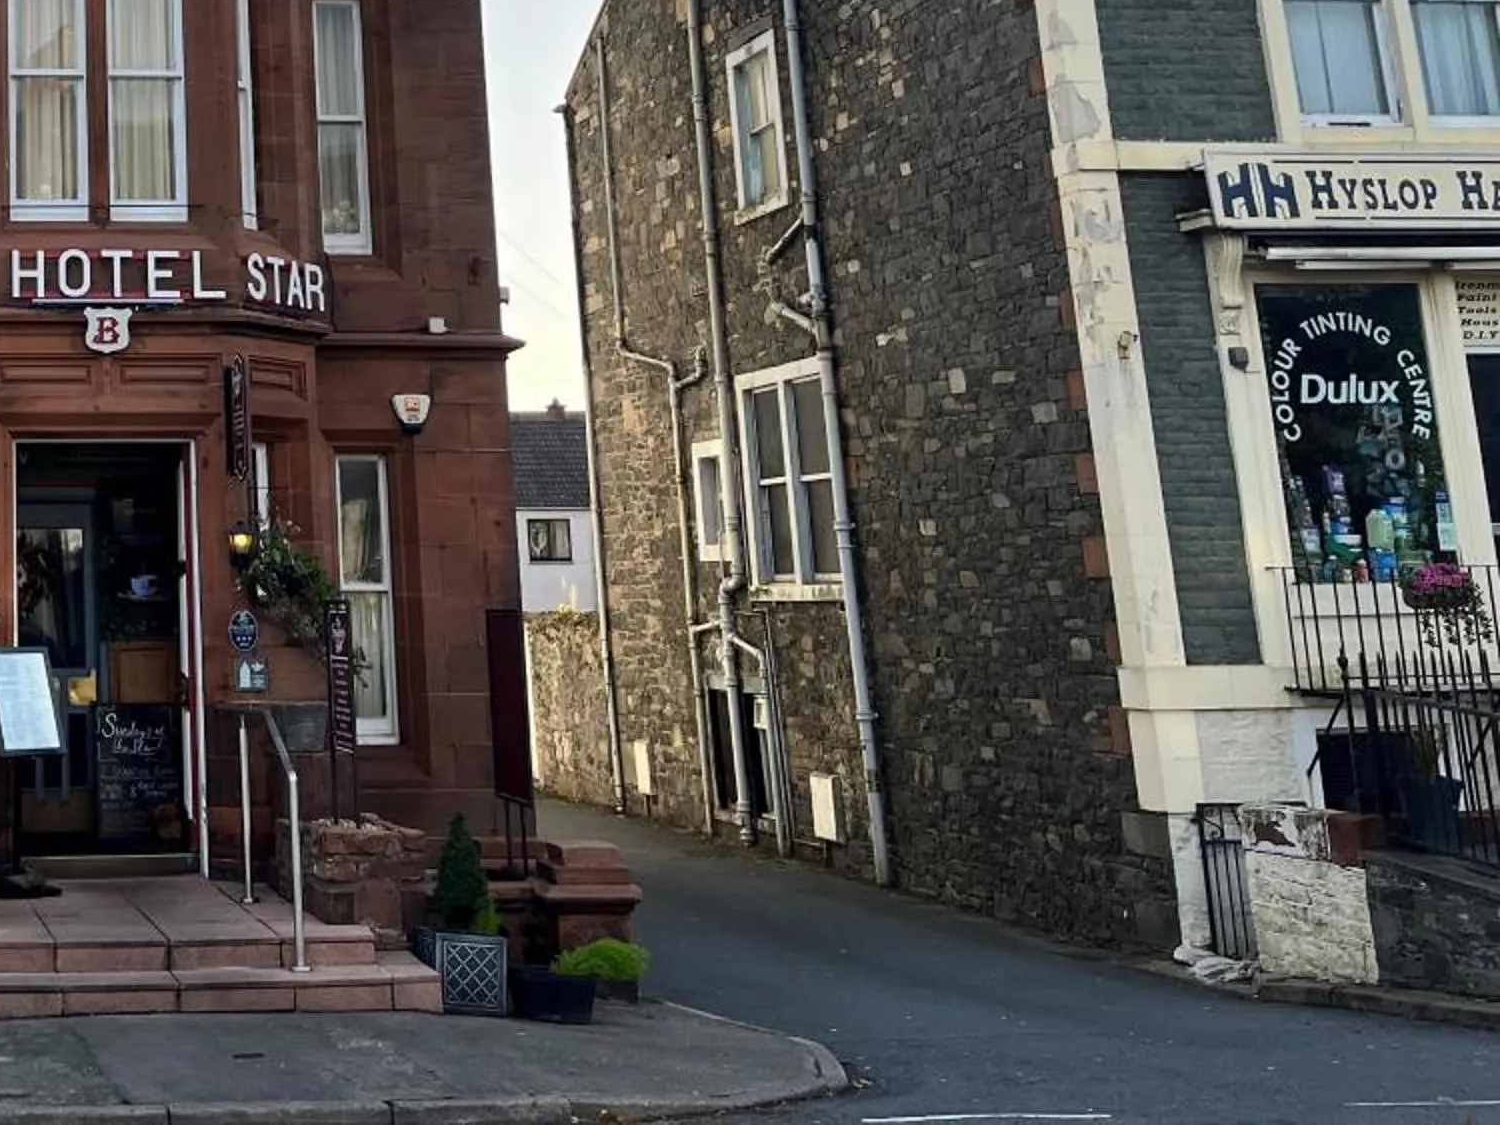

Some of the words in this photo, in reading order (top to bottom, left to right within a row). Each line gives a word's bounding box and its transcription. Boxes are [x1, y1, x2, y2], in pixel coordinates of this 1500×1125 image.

[1305, 171, 1437, 210] HYSLOP
[11, 248, 227, 300] HOTEL
[247, 252, 325, 312] STAR
[1272, 338, 1302, 441] COLOUR
[1300, 312, 1391, 345] TINTING
[1397, 349, 1432, 440] CENTRE
[1300, 373, 1400, 404] Dulux
